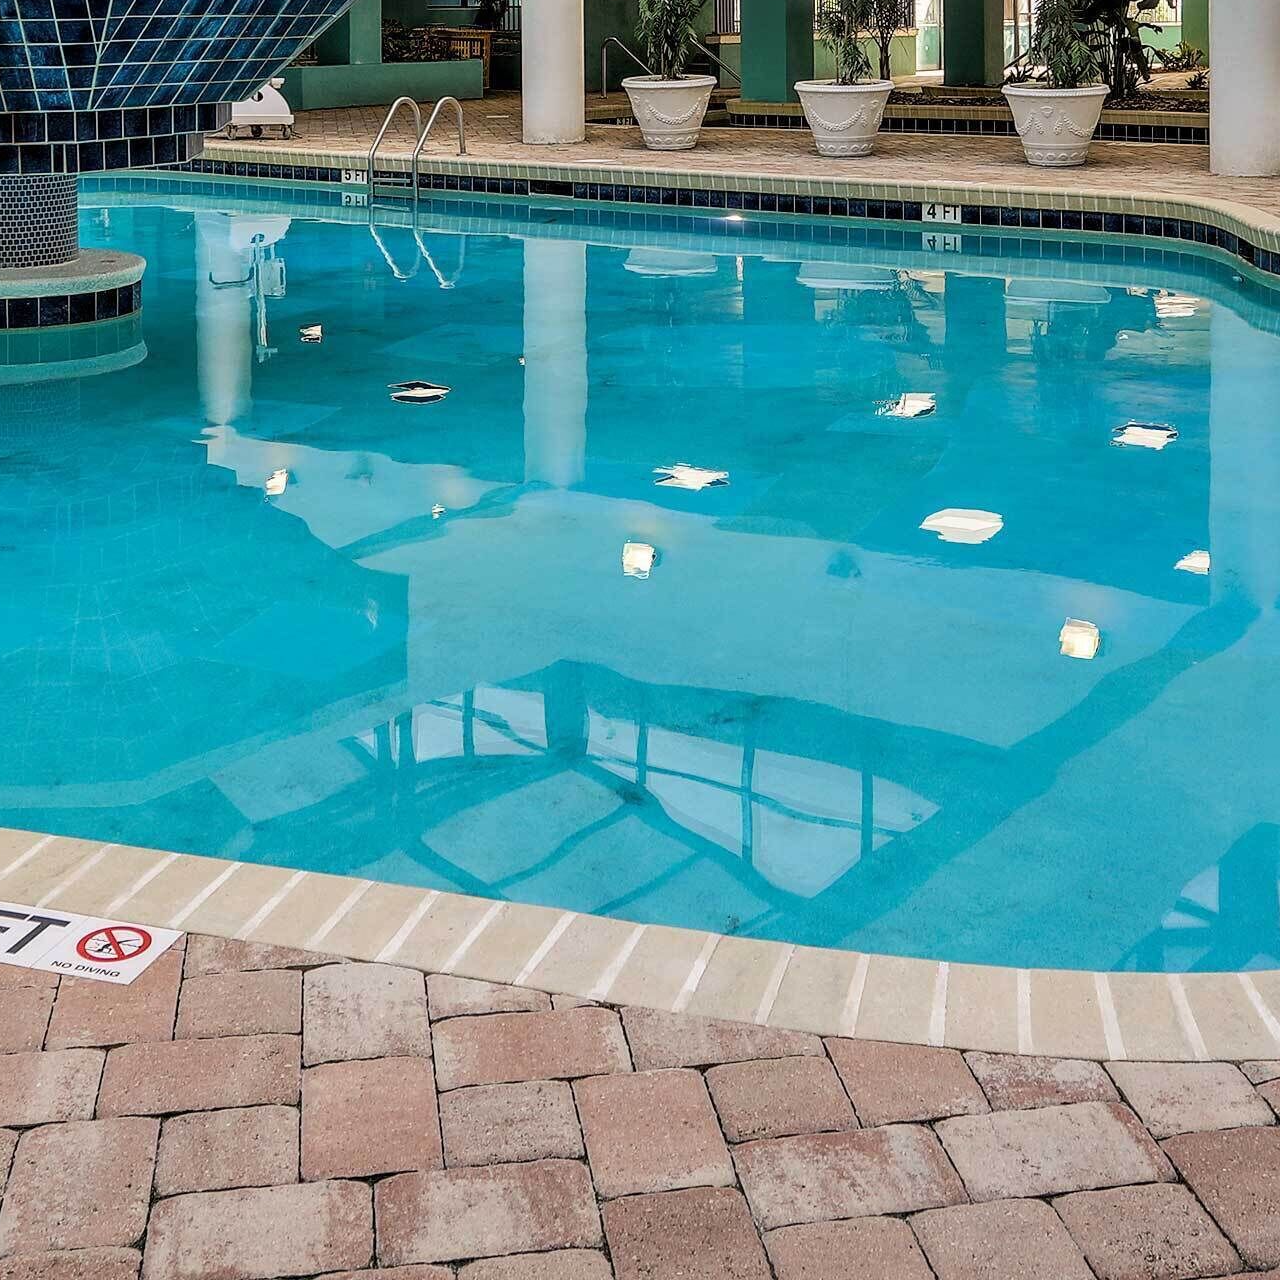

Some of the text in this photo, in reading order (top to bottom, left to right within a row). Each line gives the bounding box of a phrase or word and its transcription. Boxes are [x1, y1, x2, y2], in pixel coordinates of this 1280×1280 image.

[345, 169, 352, 181] 5
[927, 203, 959, 220] 4 FT
[51, 960, 121, 978] NO DIVING
